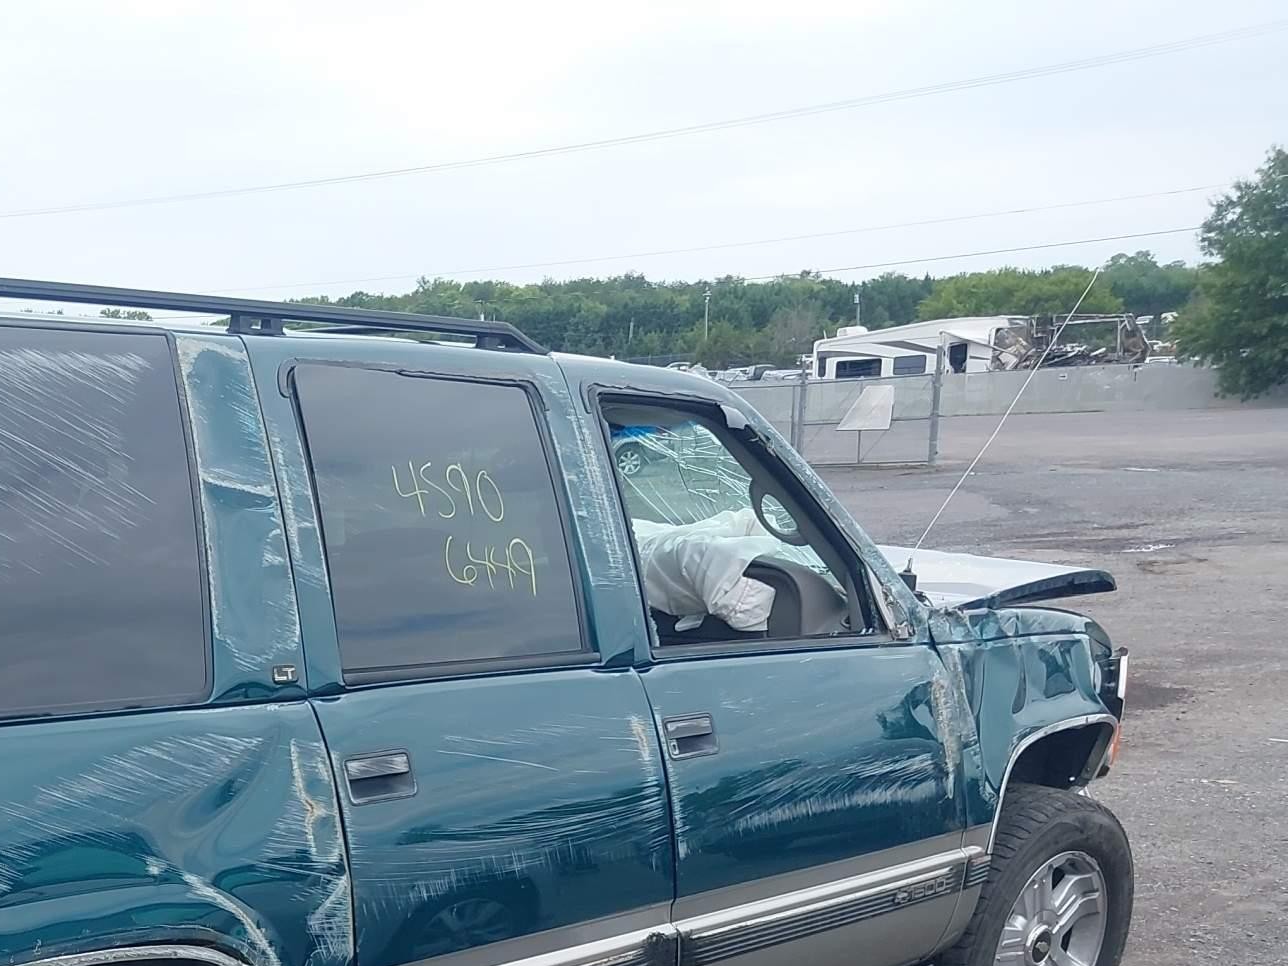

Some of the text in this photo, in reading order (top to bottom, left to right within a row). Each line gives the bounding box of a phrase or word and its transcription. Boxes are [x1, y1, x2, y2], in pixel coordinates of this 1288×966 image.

[391, 459, 504, 522] 4590
[445, 530, 537, 597] 6449
[274, 667, 296, 681] LT
